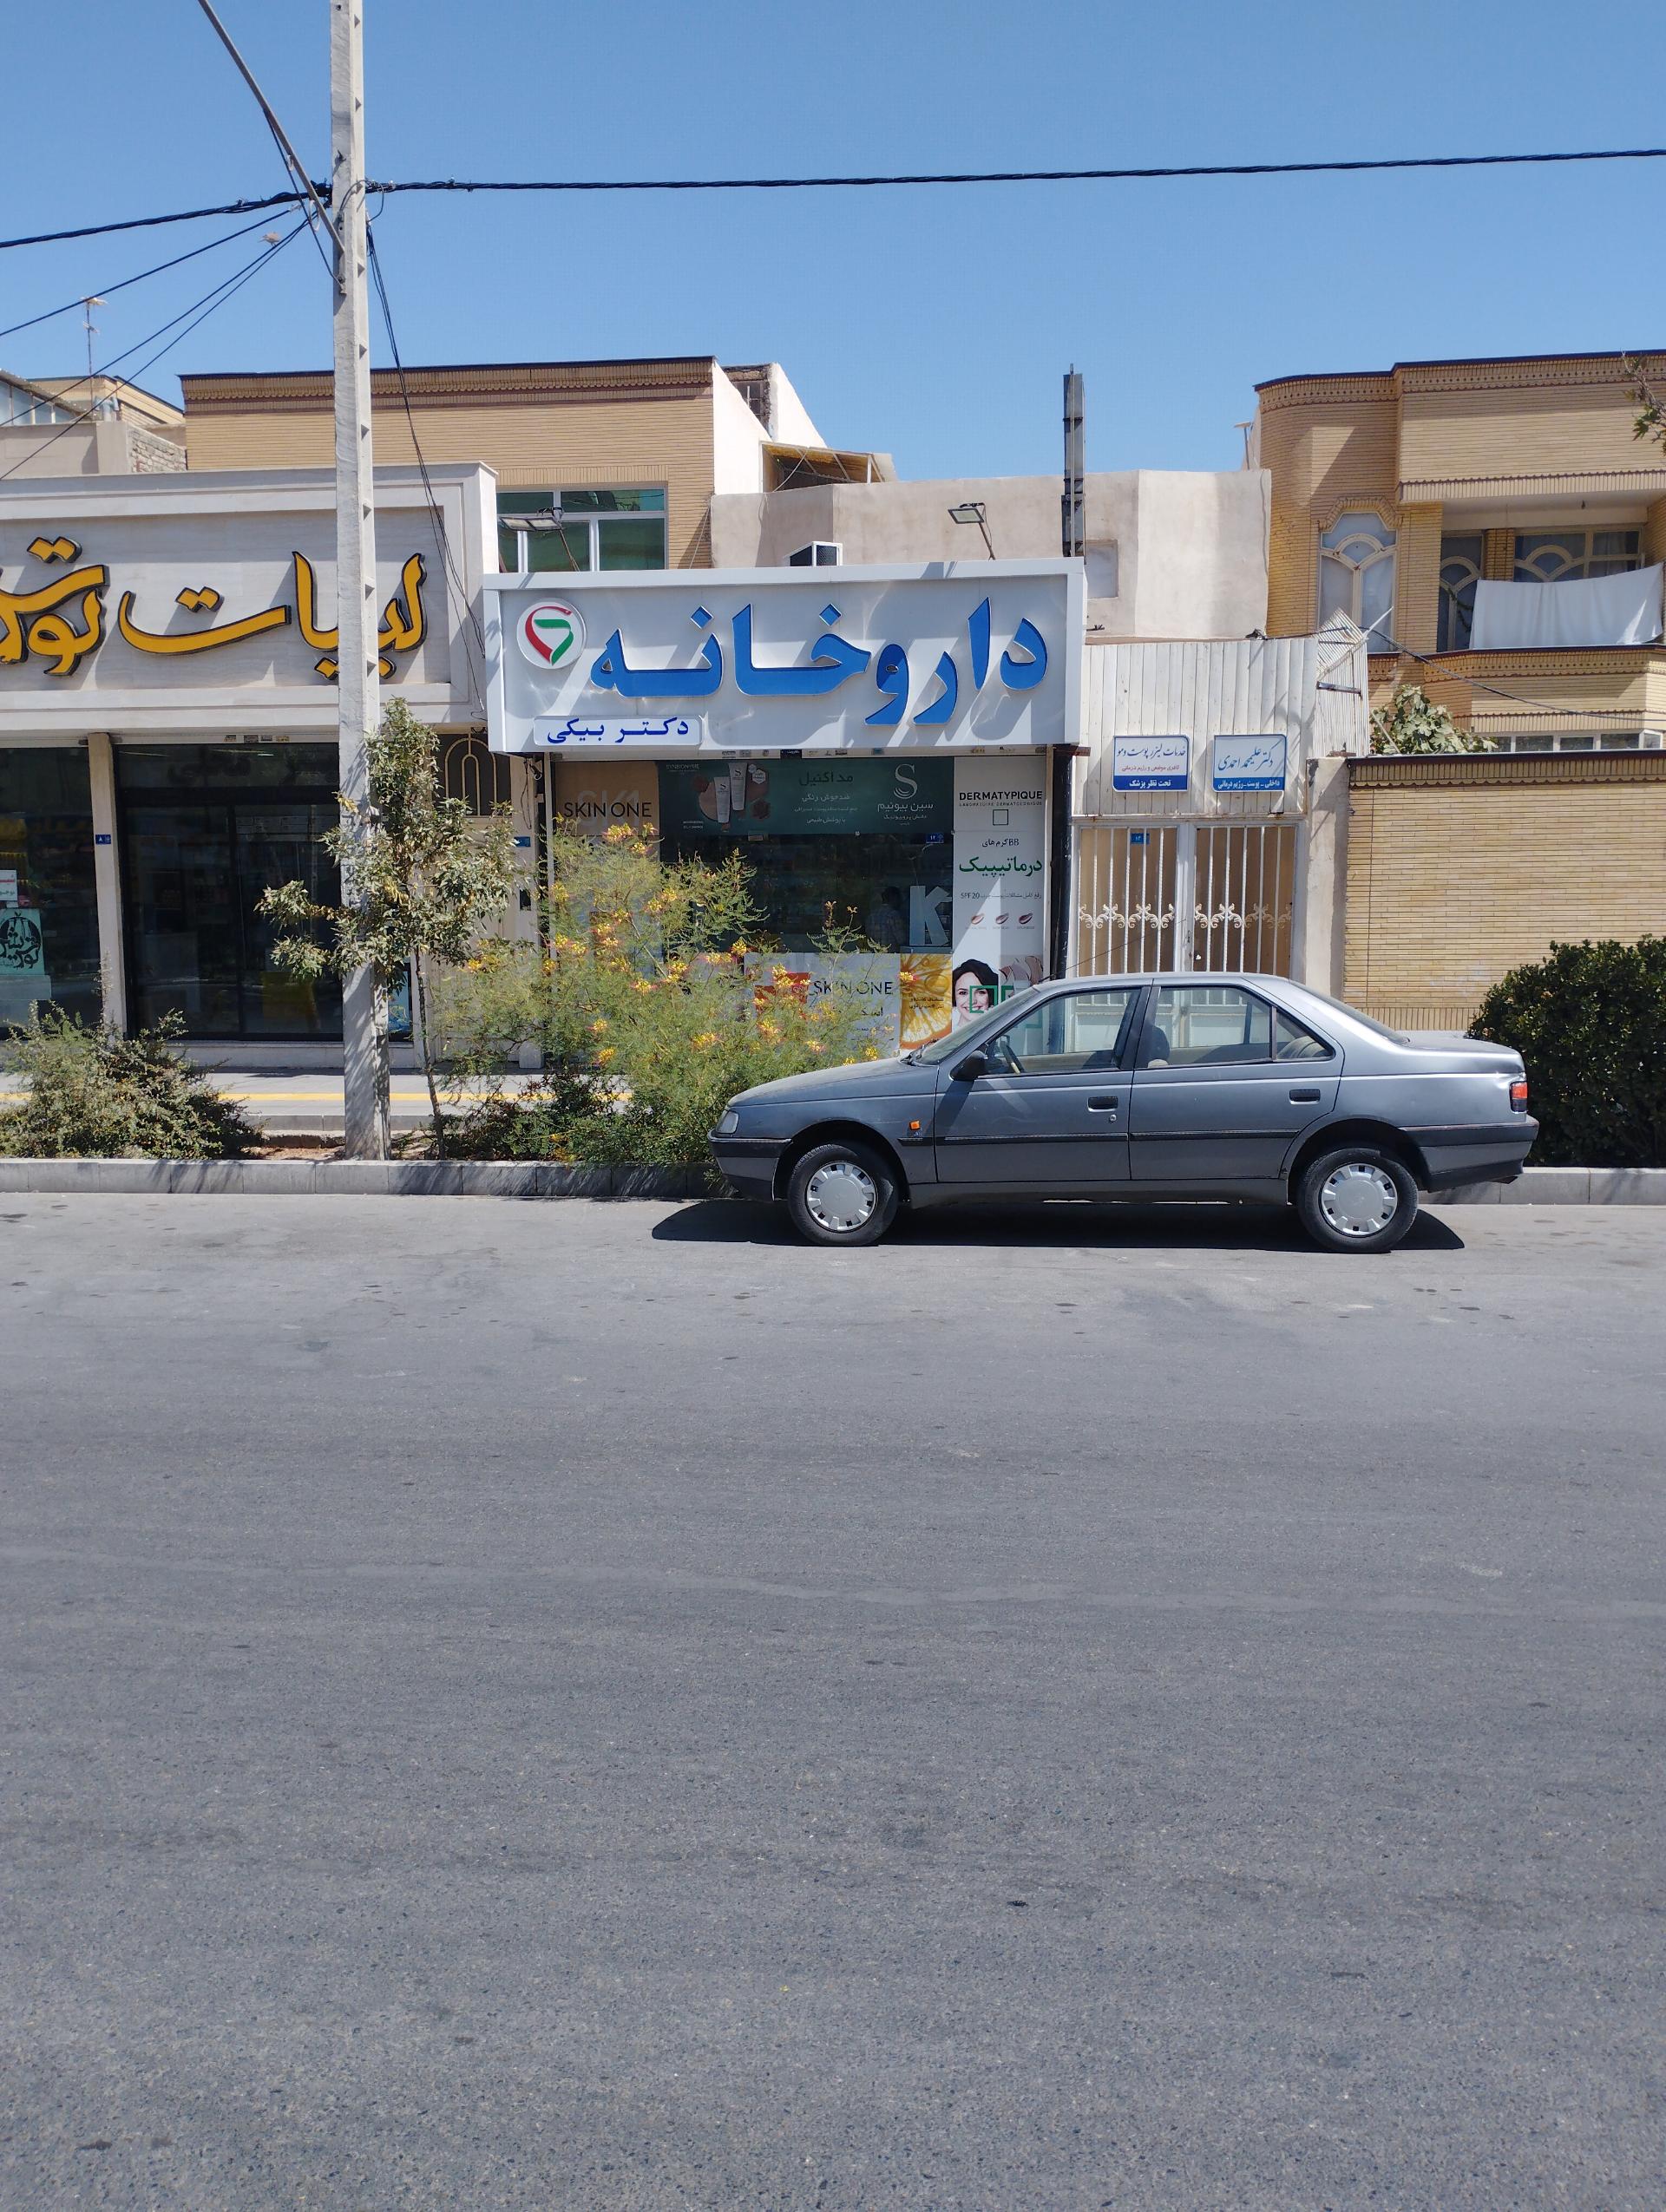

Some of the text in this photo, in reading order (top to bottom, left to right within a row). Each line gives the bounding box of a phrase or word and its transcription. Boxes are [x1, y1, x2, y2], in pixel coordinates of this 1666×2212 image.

[590, 596, 1049, 725] داروخانه
[547, 717, 689, 744] دکتر بیکی
[1127, 746, 1149, 759] پوست
[1163, 745, 1186, 756] خدمات
[1218, 755, 1240, 770] احمدی
[1129, 779, 1146, 789] پزشک
[1146, 779, 1158, 789] نظر
[1264, 780, 1281, 789] داخلی
[959, 791, 1043, 801] DERMATYPIQUE
[563, 802, 652, 818] SKIN ONE
[910, 802, 934, 812] سین
[959, 856, 1042, 878] درماتیپیک
[812, 980, 894, 995] SKN ONE
